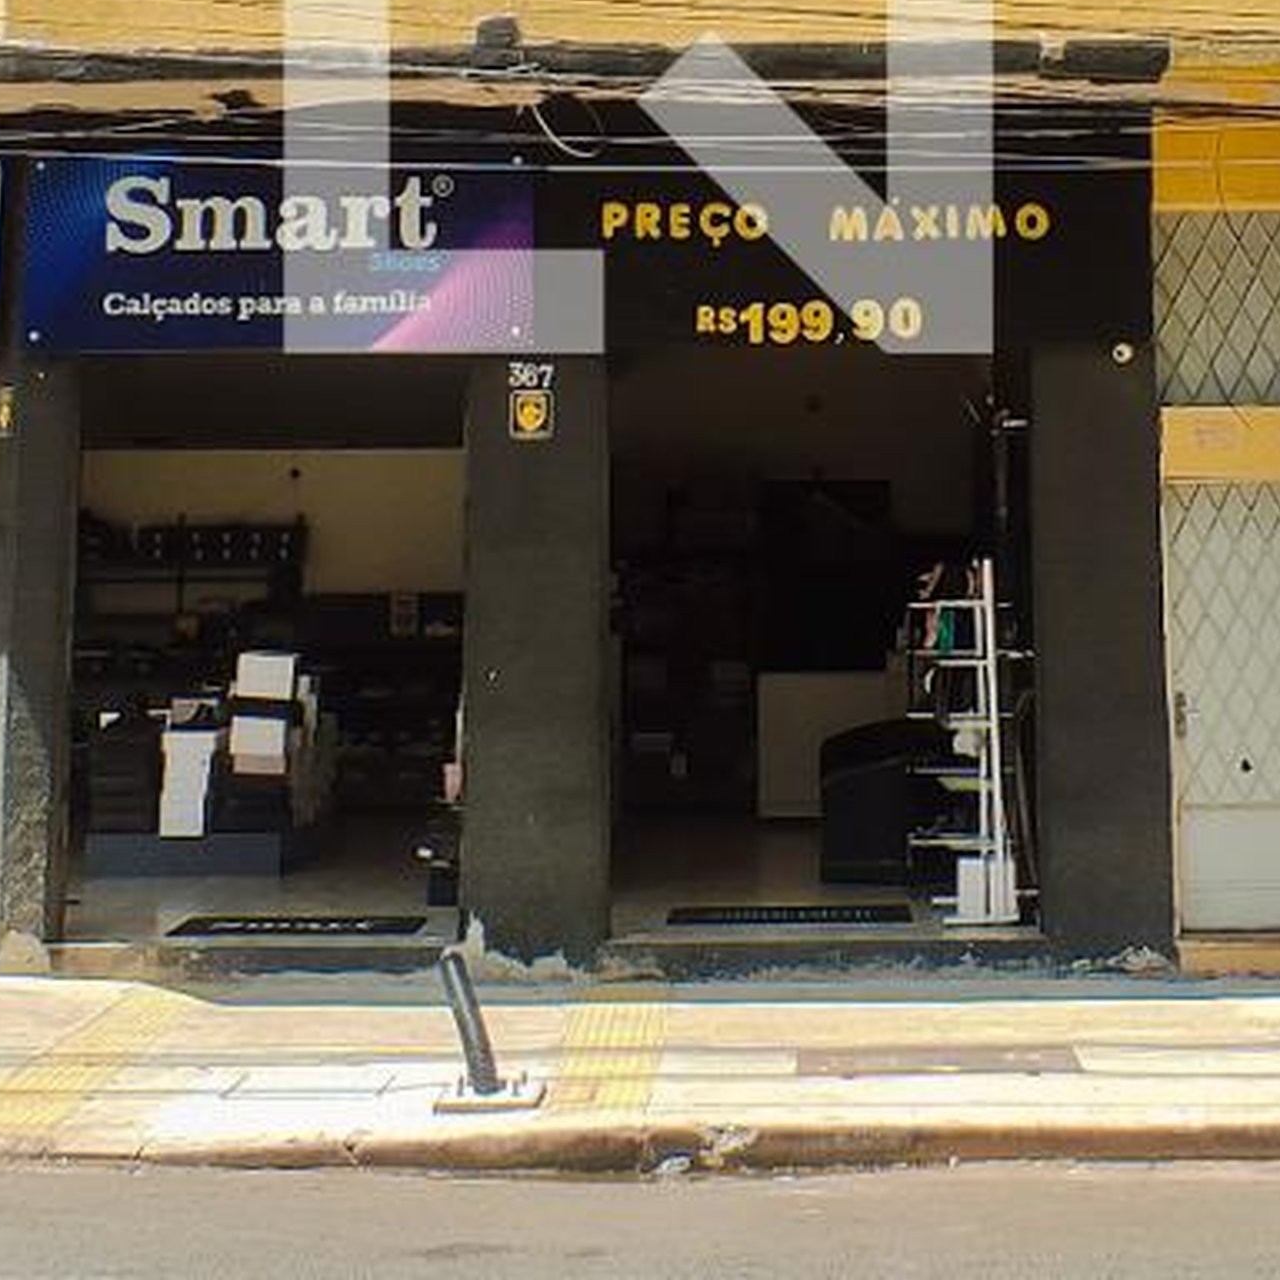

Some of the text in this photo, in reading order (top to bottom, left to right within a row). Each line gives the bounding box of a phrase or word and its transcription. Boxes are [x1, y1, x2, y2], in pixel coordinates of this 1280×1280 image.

[104, 175, 437, 254] Smart
[603, 196, 1050, 247] PREÇO MÁXIMO
[103, 292, 232, 320] Calçados
[237, 296, 301, 319] para
[309, 294, 326, 314] a
